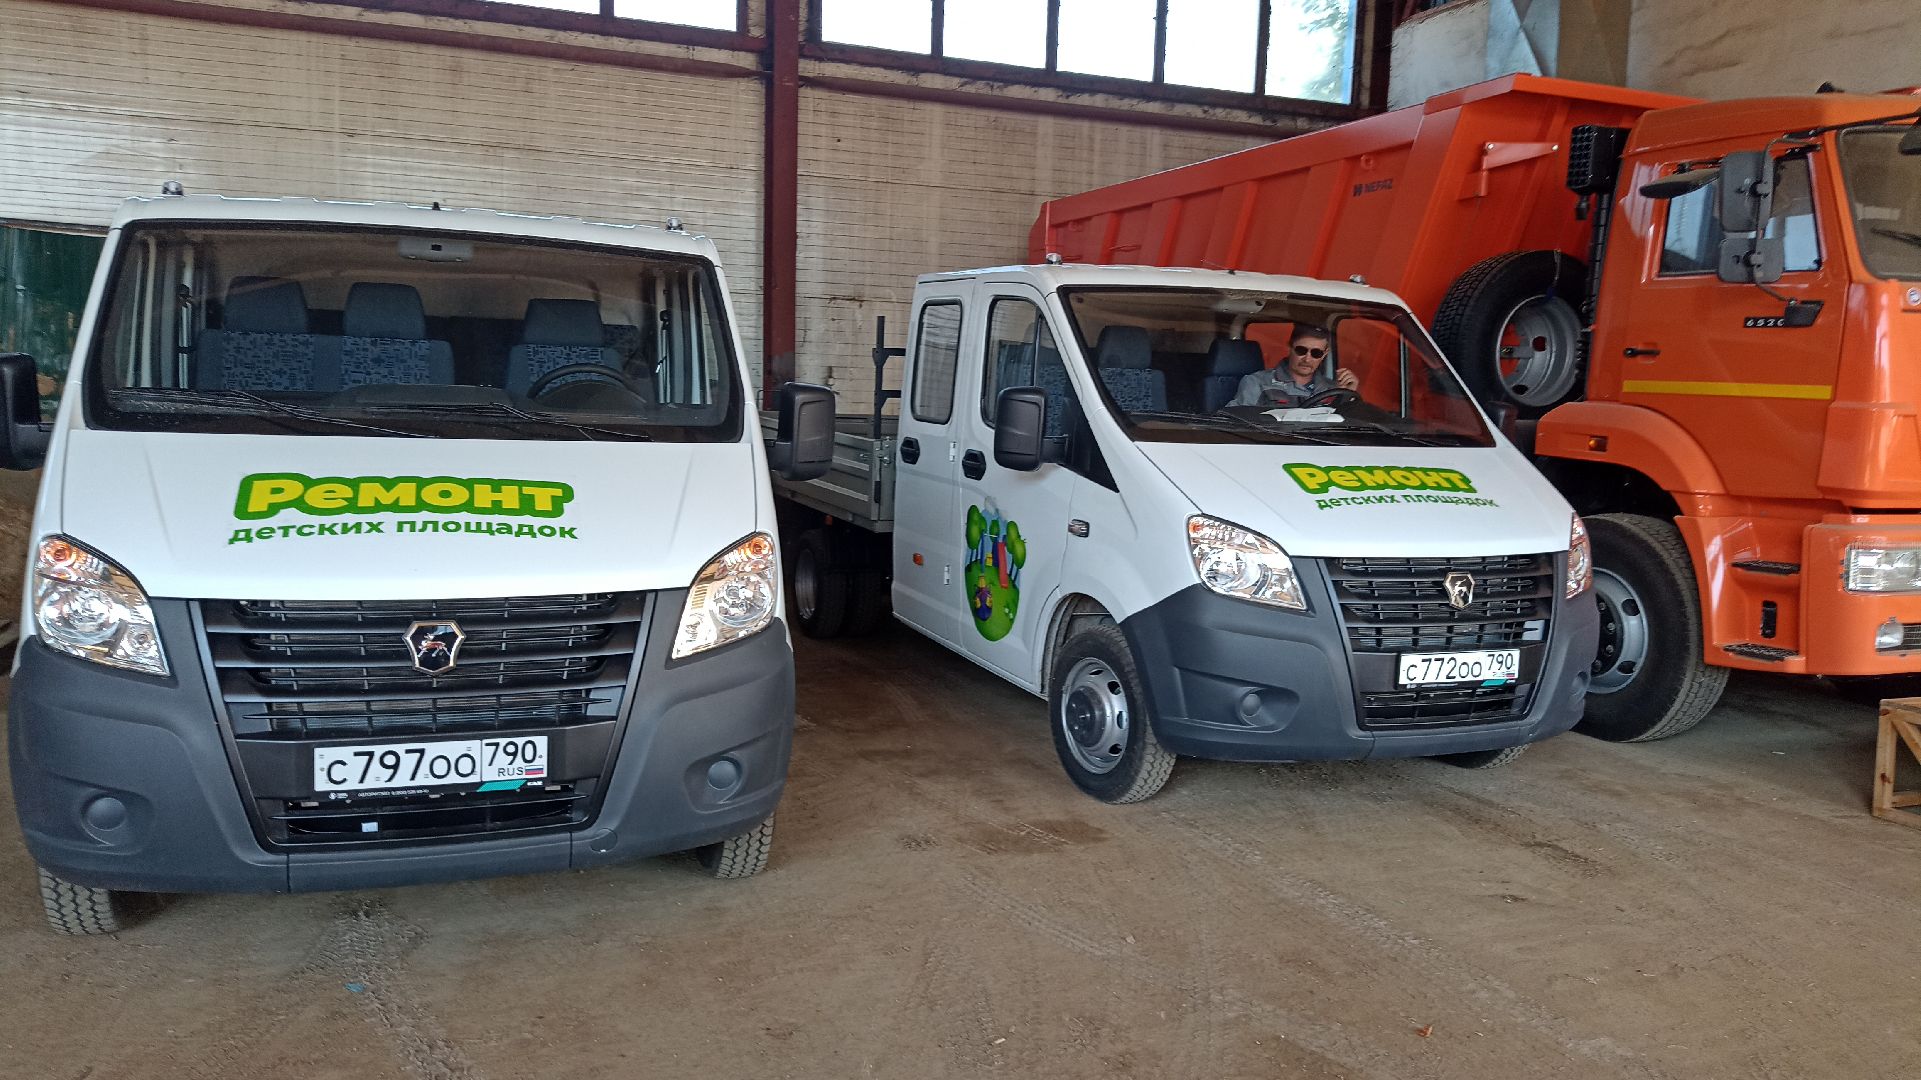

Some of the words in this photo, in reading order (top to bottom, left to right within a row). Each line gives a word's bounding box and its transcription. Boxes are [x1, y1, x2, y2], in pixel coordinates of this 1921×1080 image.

[1291, 467, 1470, 489] Ремонт
[247, 479, 564, 513] Ремонт
[1315, 495, 1400, 511] детских
[1401, 494, 1500, 508] площадок
[228, 520, 384, 545] детских
[396, 520, 579, 540] площадок
[484, 739, 537, 767] 790
[497, 766, 524, 778] RUS
